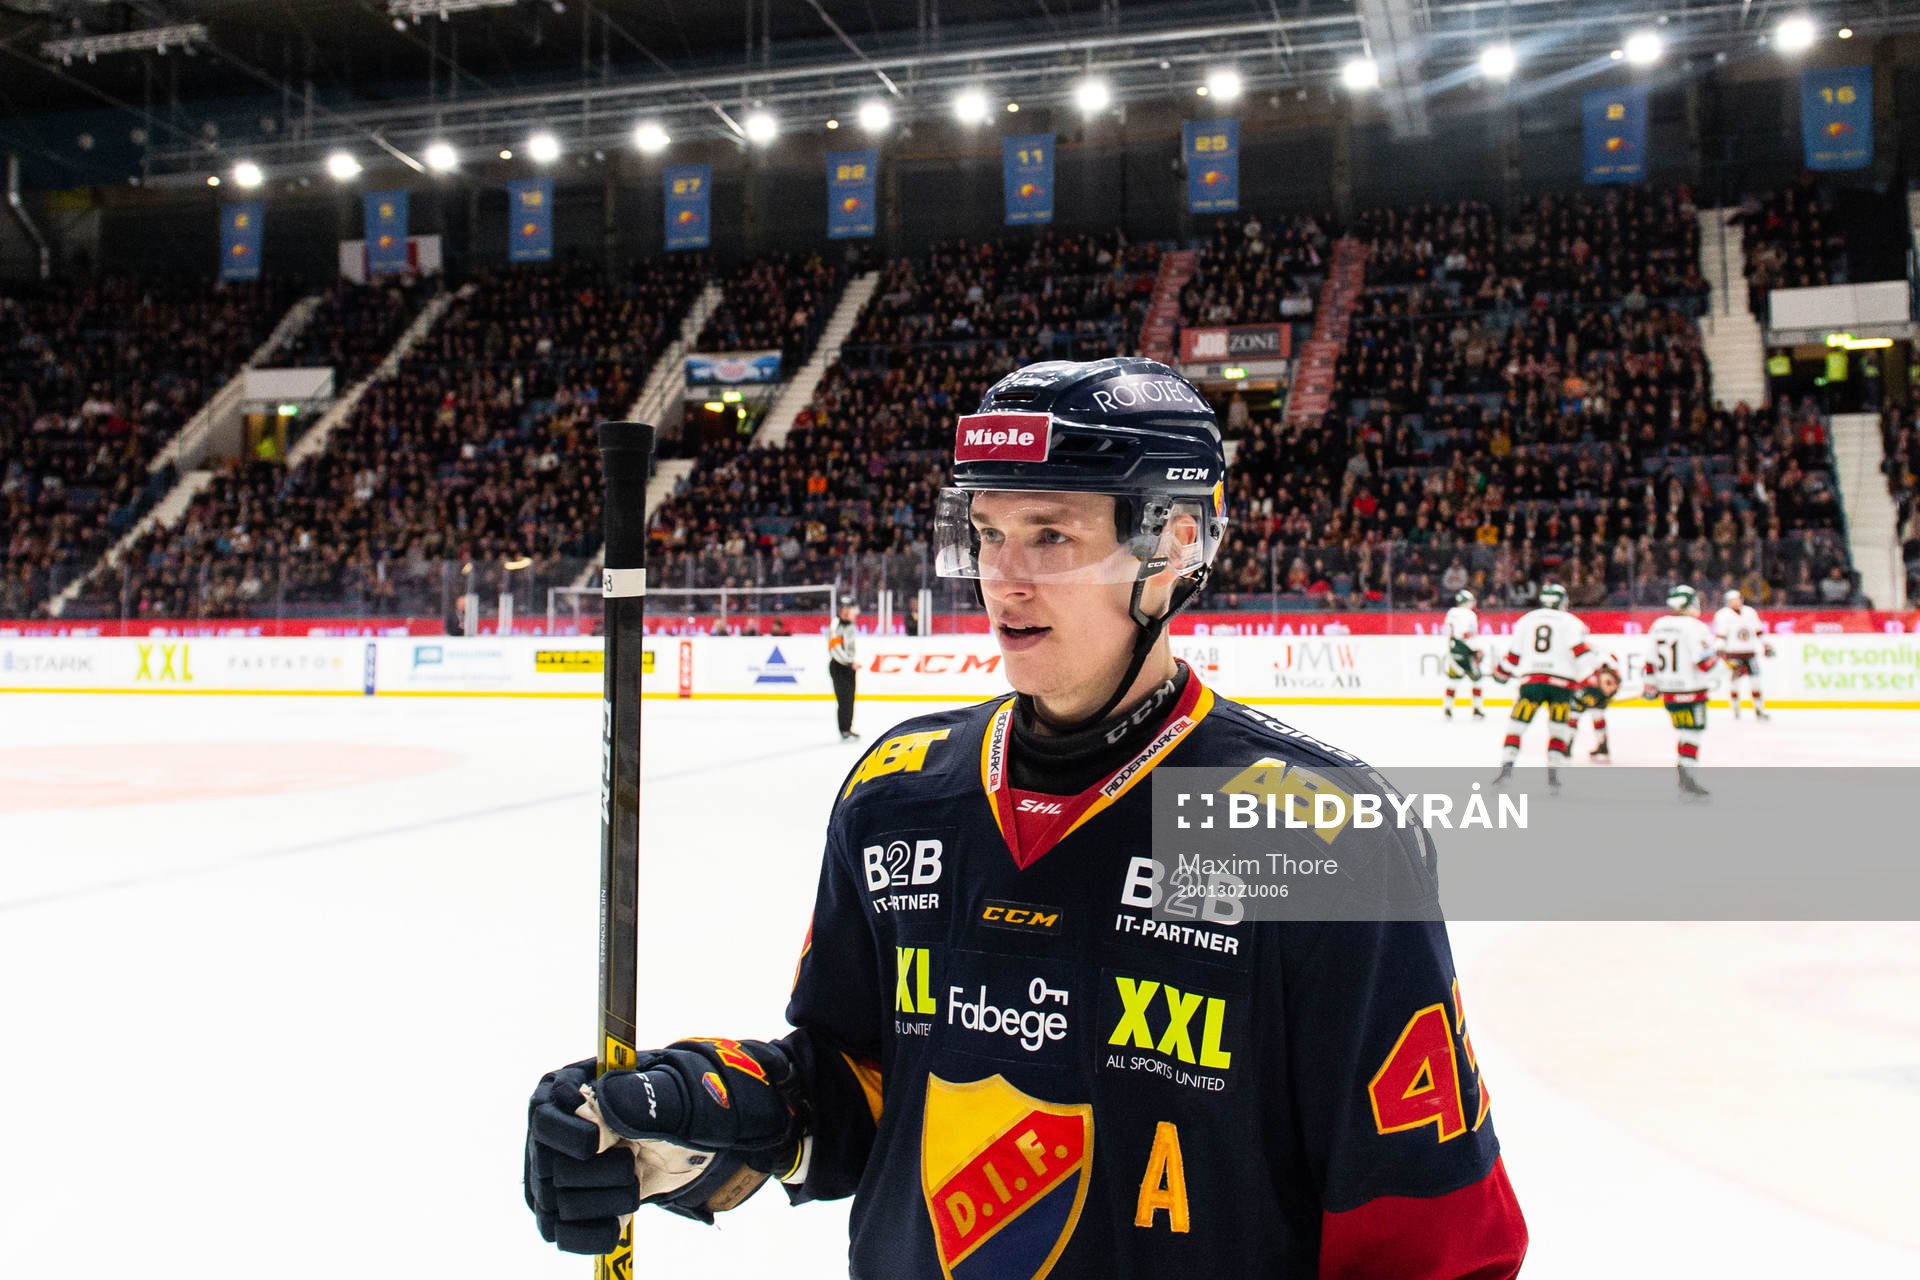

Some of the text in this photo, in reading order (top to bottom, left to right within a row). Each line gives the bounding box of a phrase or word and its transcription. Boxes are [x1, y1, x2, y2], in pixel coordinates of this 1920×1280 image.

[1018, 148, 1043, 164] 11
[1092, 380, 1194, 413] ROTOTEC
[964, 428, 1035, 447] Miele
[1165, 467, 1210, 480] CCM
[1147, 560, 1167, 569] CCM
[1534, 625, 1552, 653] 8
[1656, 640, 1679, 673] 51
[136, 644, 193, 681] XXL
[869, 654, 1002, 674] CCM
[1331, 675, 1361, 688] AB
[843, 728, 952, 801] ABT
[1104, 720, 1195, 797] RIDDERMARK BIL
[1016, 799, 1063, 815] SHL
[863, 839, 943, 892] B2B
[1120, 856, 1245, 926] B2B
[982, 906, 1060, 927] CCM
[1115, 914, 1239, 955] IT-PARTNER
[895, 946, 937, 1014] XL
[948, 984, 1068, 1052] Fabege
[1108, 976, 1232, 1070] XXL
[1106, 1054, 1226, 1092] ALL SPORTS UNITED
[1133, 1120, 1191, 1234] A
